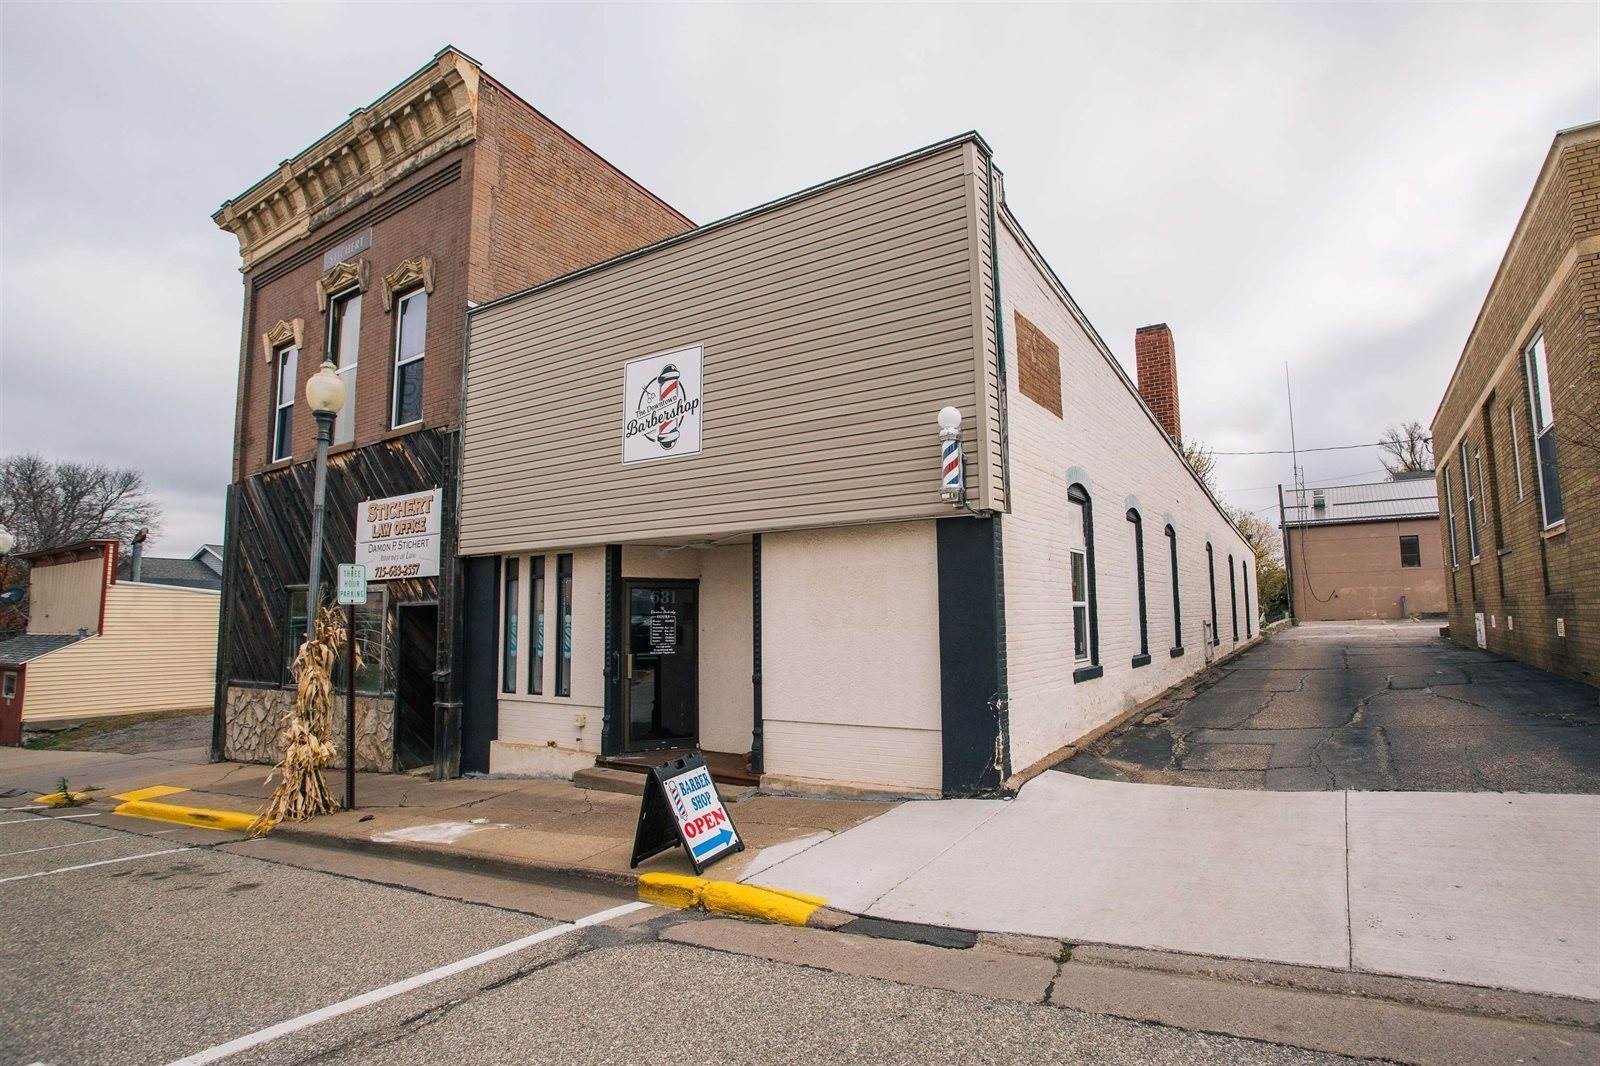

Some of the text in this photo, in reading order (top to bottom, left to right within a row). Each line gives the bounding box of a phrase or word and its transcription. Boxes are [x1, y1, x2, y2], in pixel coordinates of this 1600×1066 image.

[635, 395, 678, 418] The Downtown
[625, 398, 699, 439] Barbershop
[367, 495, 434, 522] STICHERT
[372, 517, 427, 538] LAW OFFICE
[368, 543, 391, 553] DAMON
[398, 539, 430, 550] STICHERT
[340, 590, 364, 598] PARKING
[678, 772, 711, 796] BARBER
[690, 791, 712, 811] SHOP
[684, 807, 726, 838] OPEN
